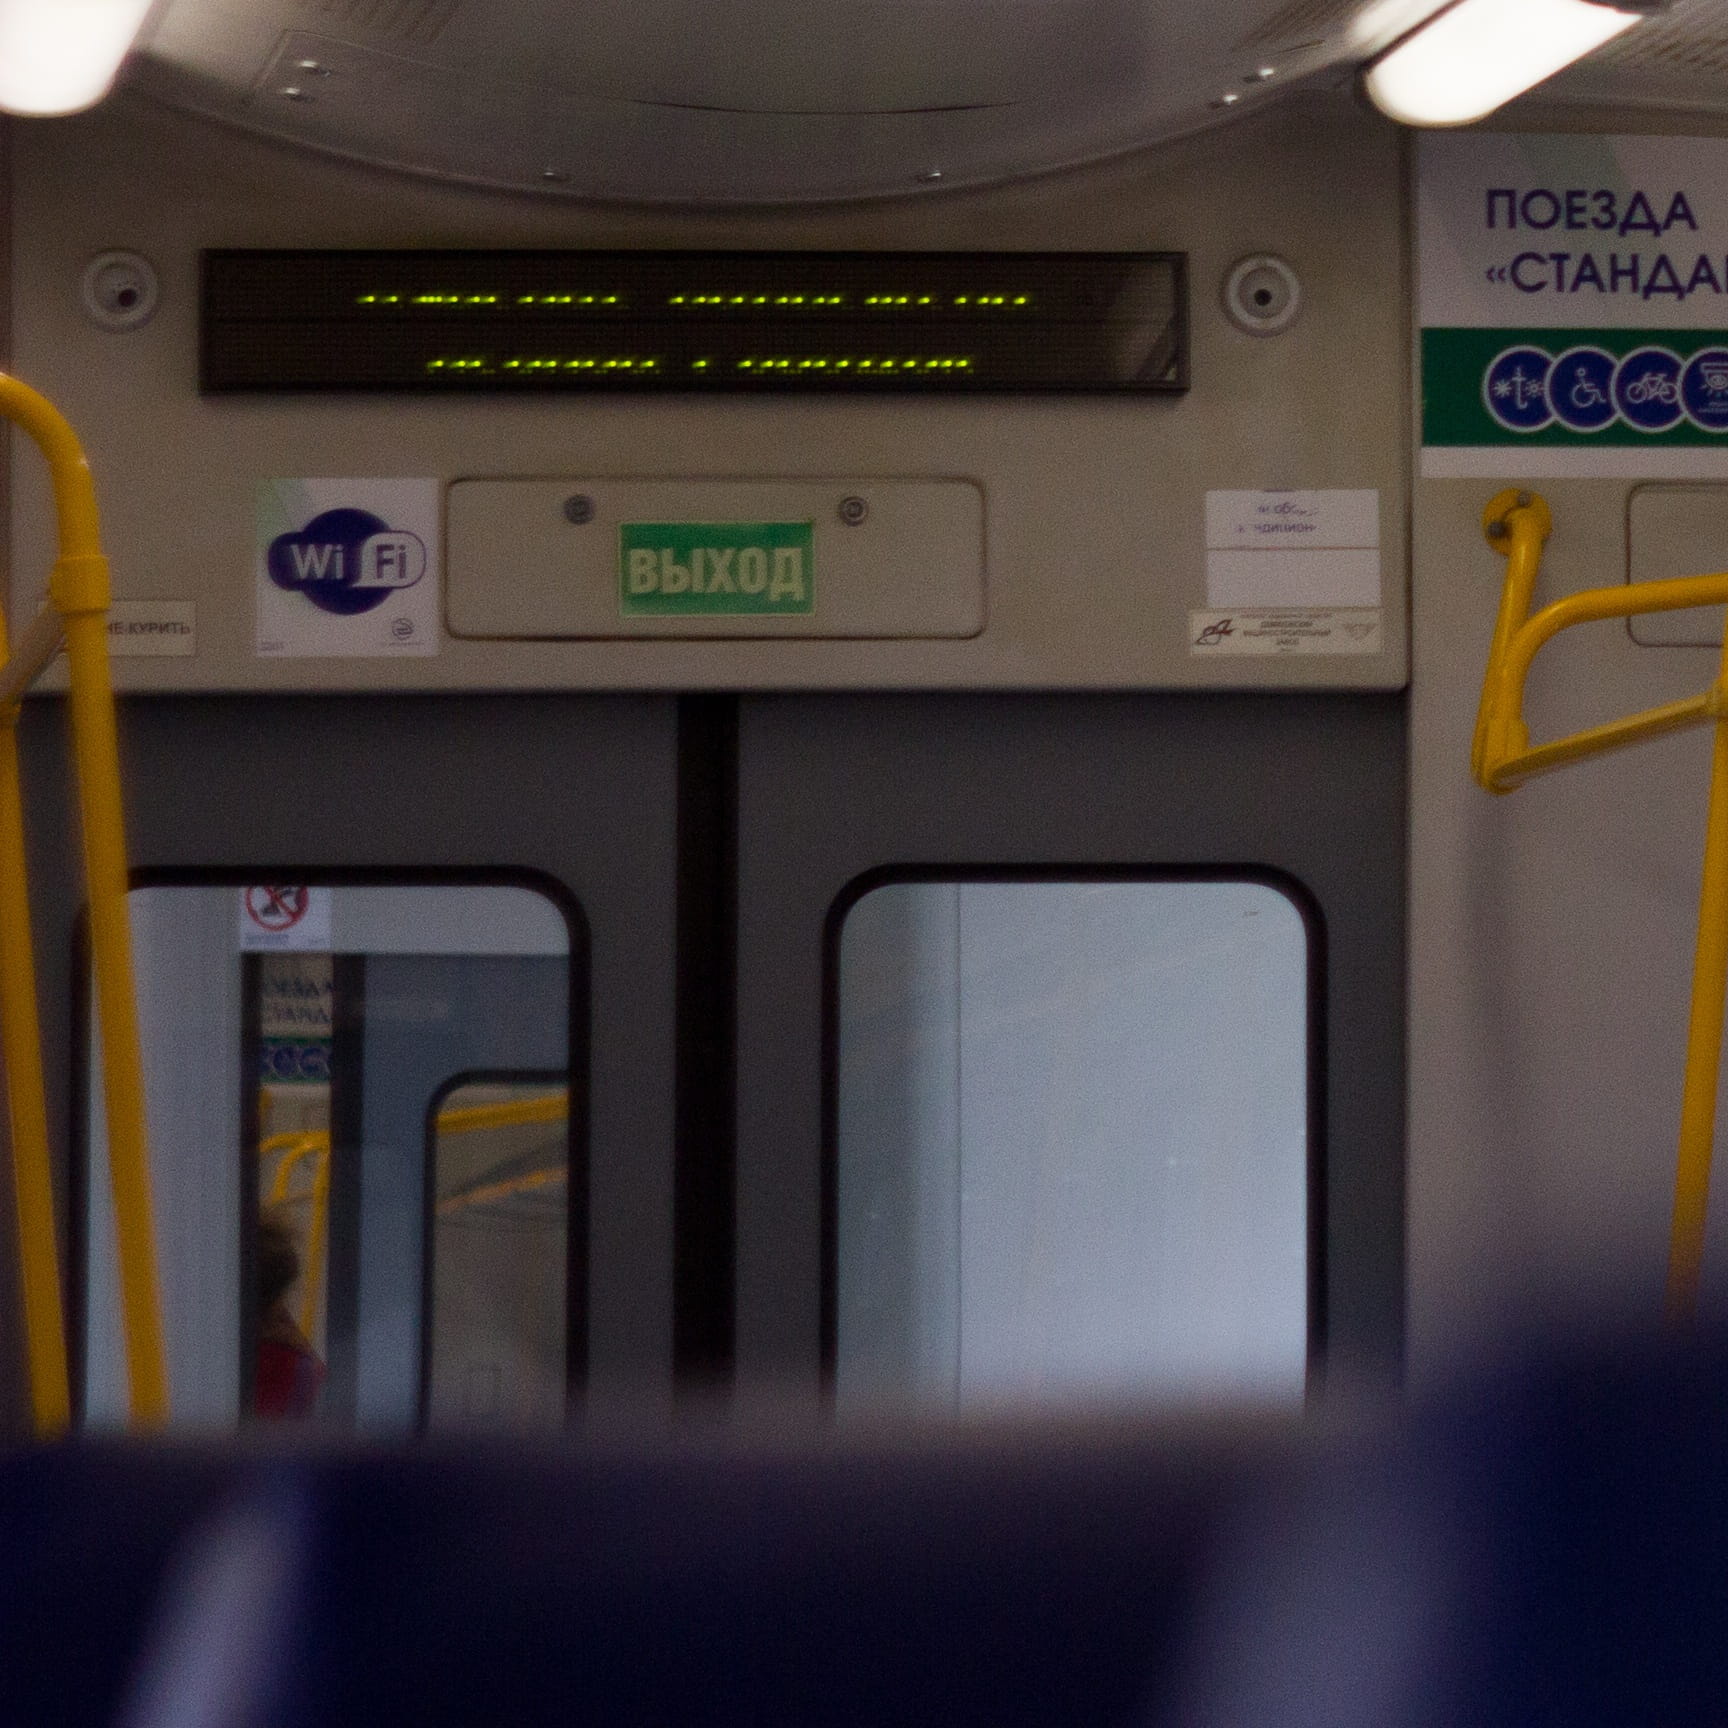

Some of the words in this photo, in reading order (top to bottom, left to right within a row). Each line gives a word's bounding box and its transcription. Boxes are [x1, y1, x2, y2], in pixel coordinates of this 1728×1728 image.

[1485, 188, 1698, 238] ПОЕЗДА
[628, 546, 806, 603] ВЫХОД
[127, 622, 191, 635] КУРИТЬ
